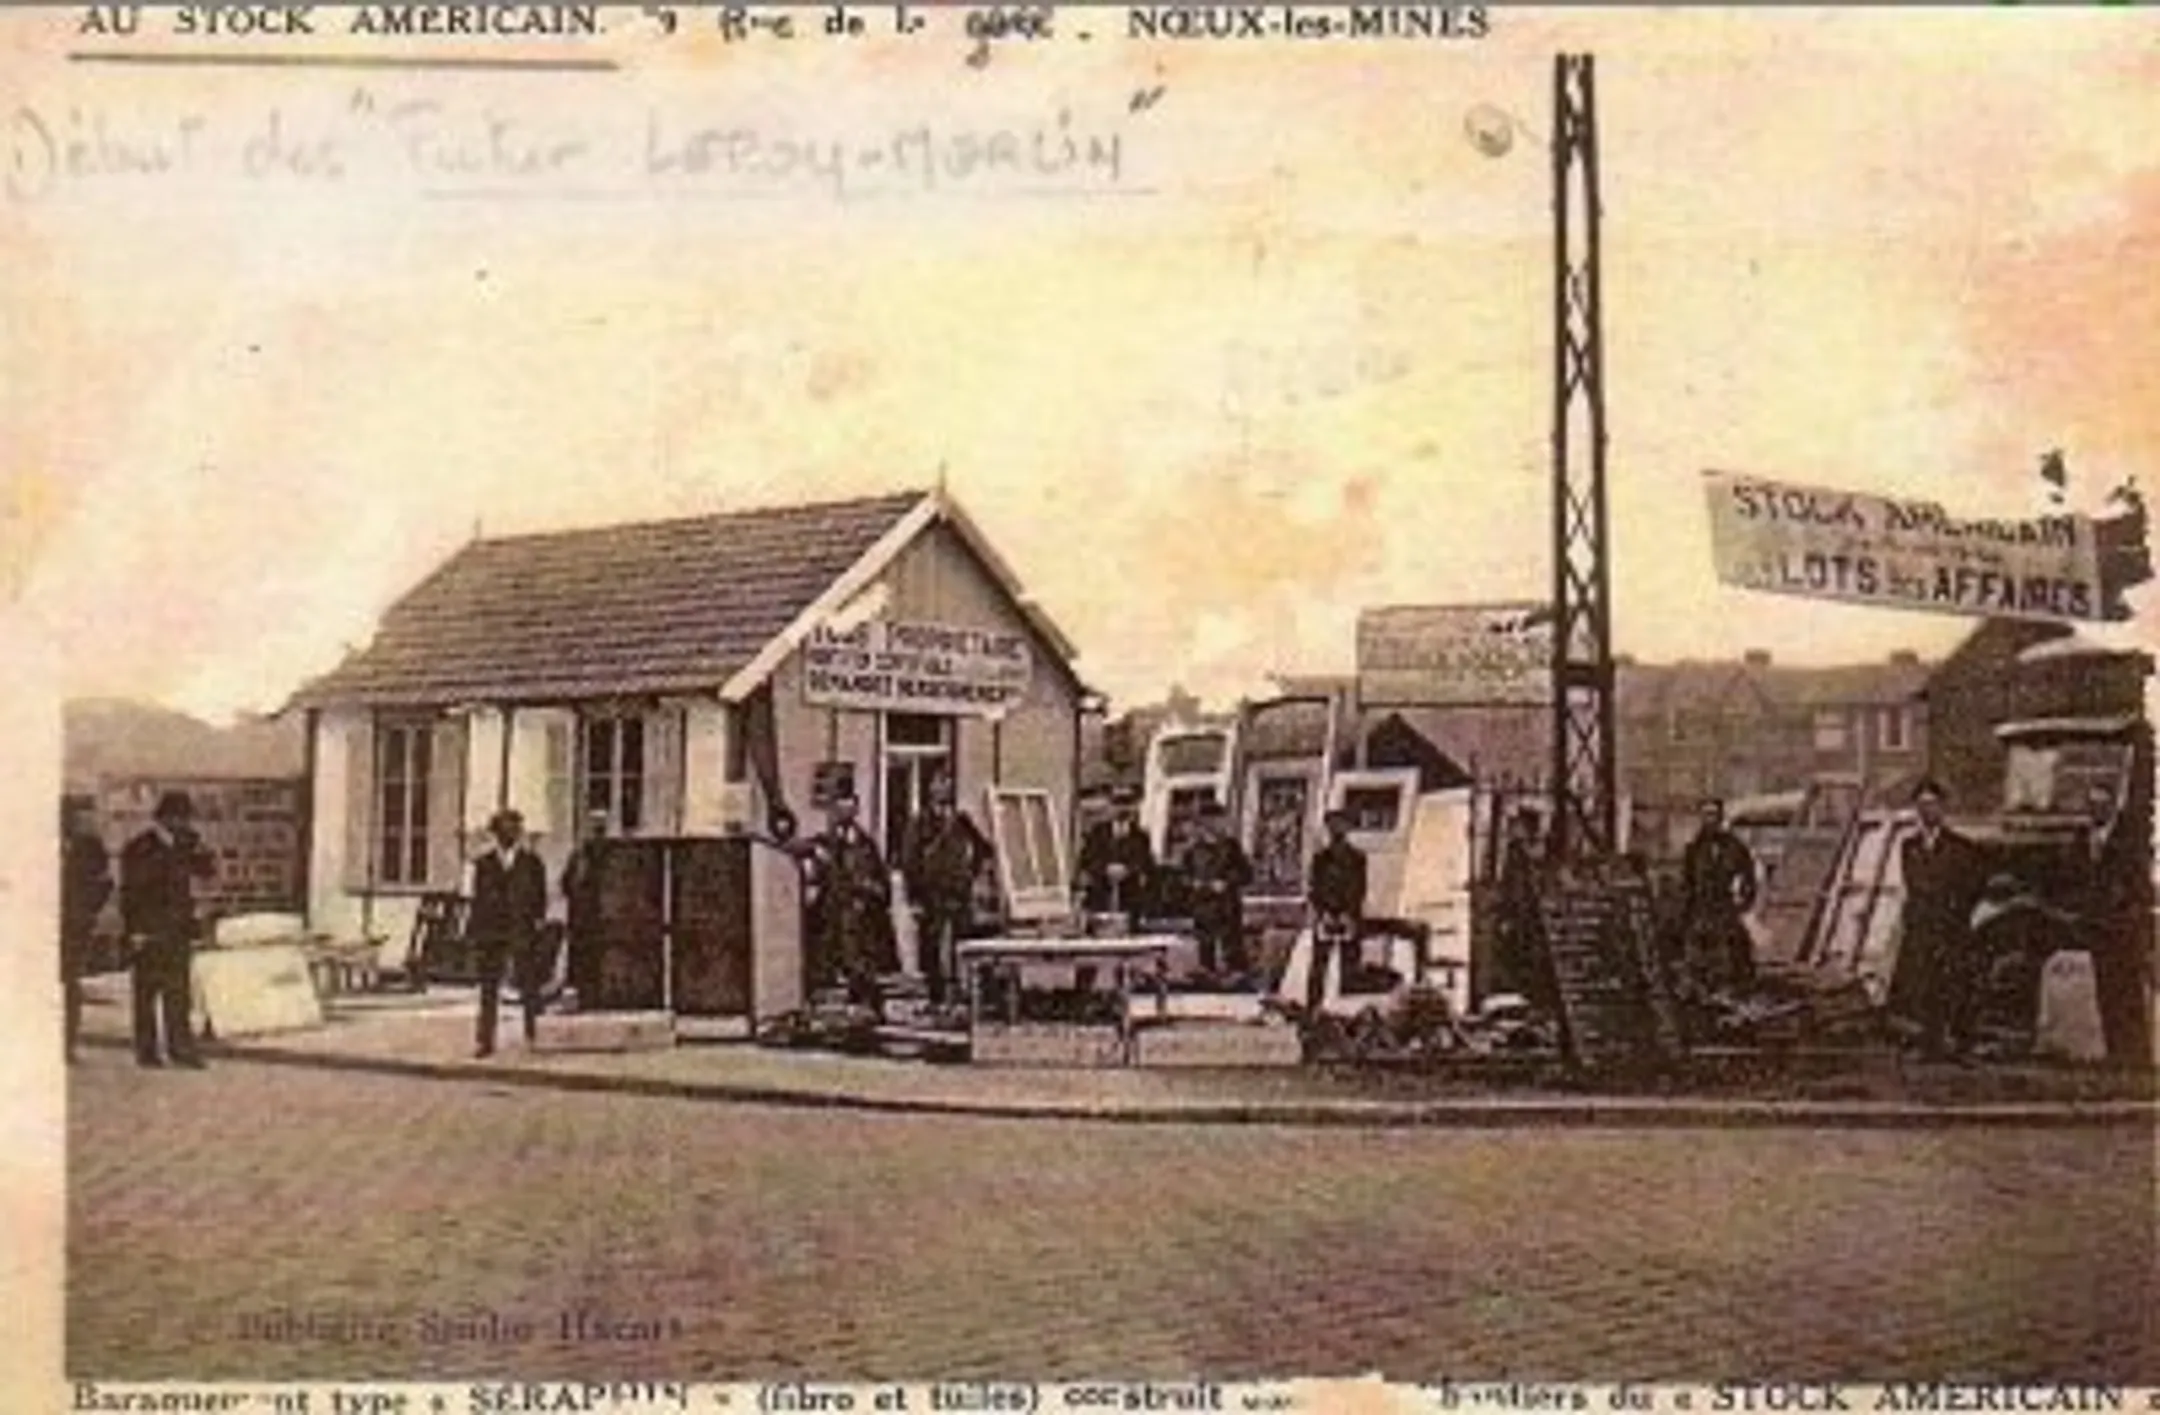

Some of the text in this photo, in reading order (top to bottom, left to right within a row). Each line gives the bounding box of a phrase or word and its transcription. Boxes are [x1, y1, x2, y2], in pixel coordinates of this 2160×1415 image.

[1732, 482, 1866, 530] STOCK
[1780, 550, 1879, 595] LOTS
[1930, 565, 2092, 617] AFFAIRES
